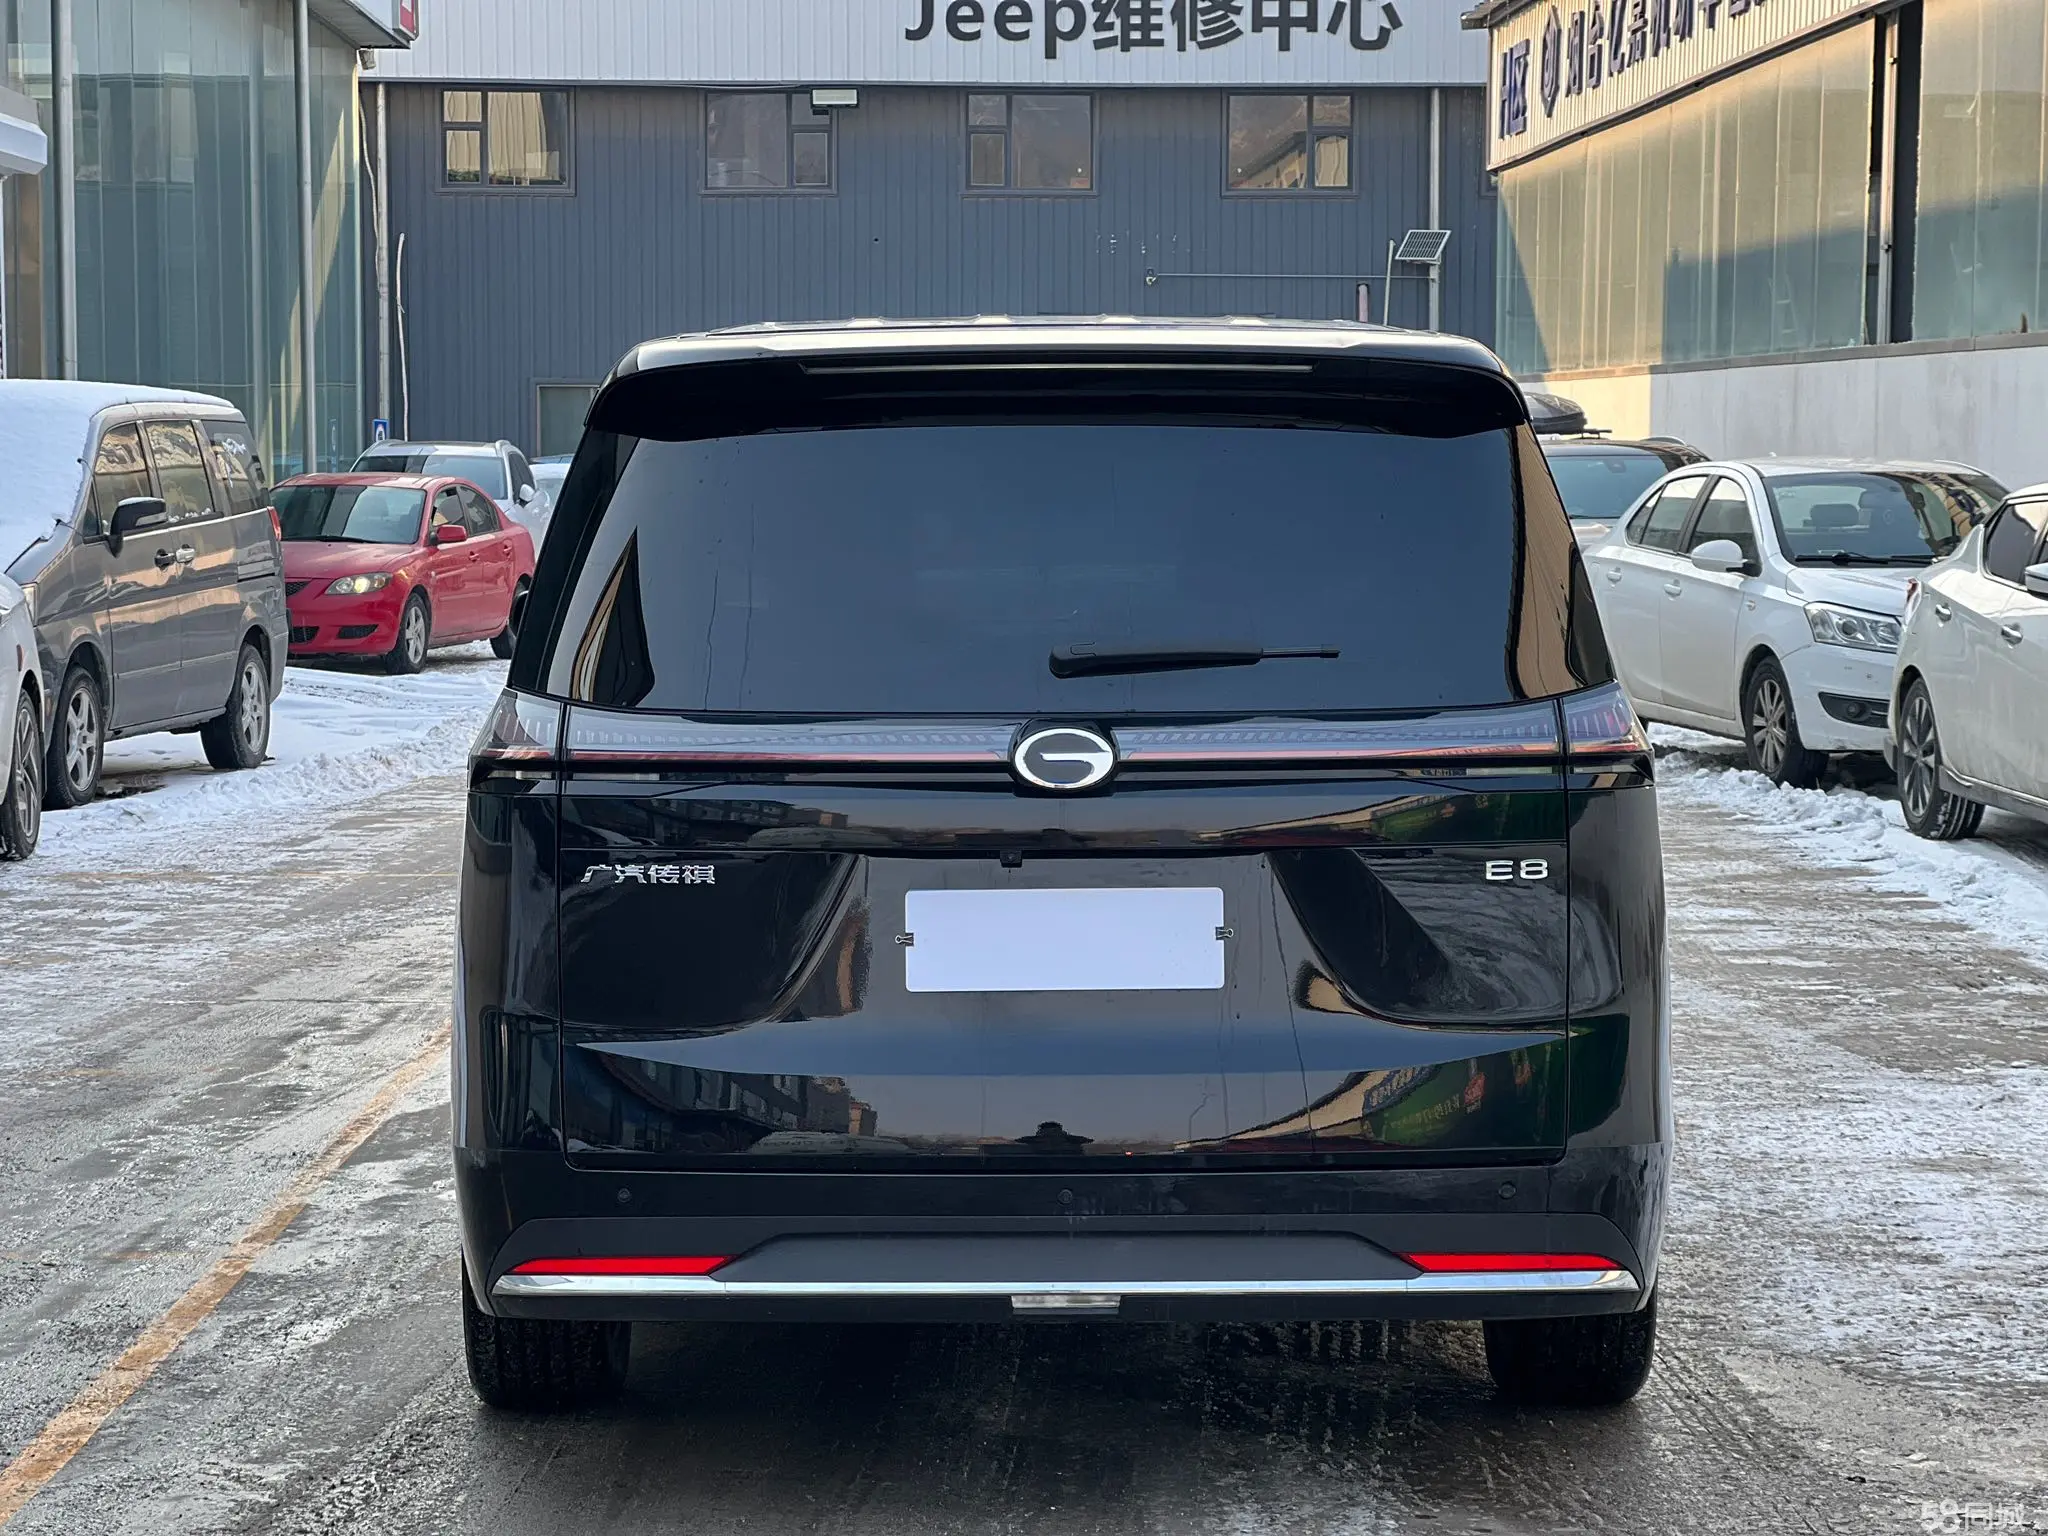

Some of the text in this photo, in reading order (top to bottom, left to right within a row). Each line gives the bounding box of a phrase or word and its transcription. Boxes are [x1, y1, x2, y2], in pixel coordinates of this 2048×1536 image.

[904, 0, 1403, 59] Jeep维修中心
[580, 864, 716, 885] 广汽传祺
[1486, 858, 1548, 880] E8
